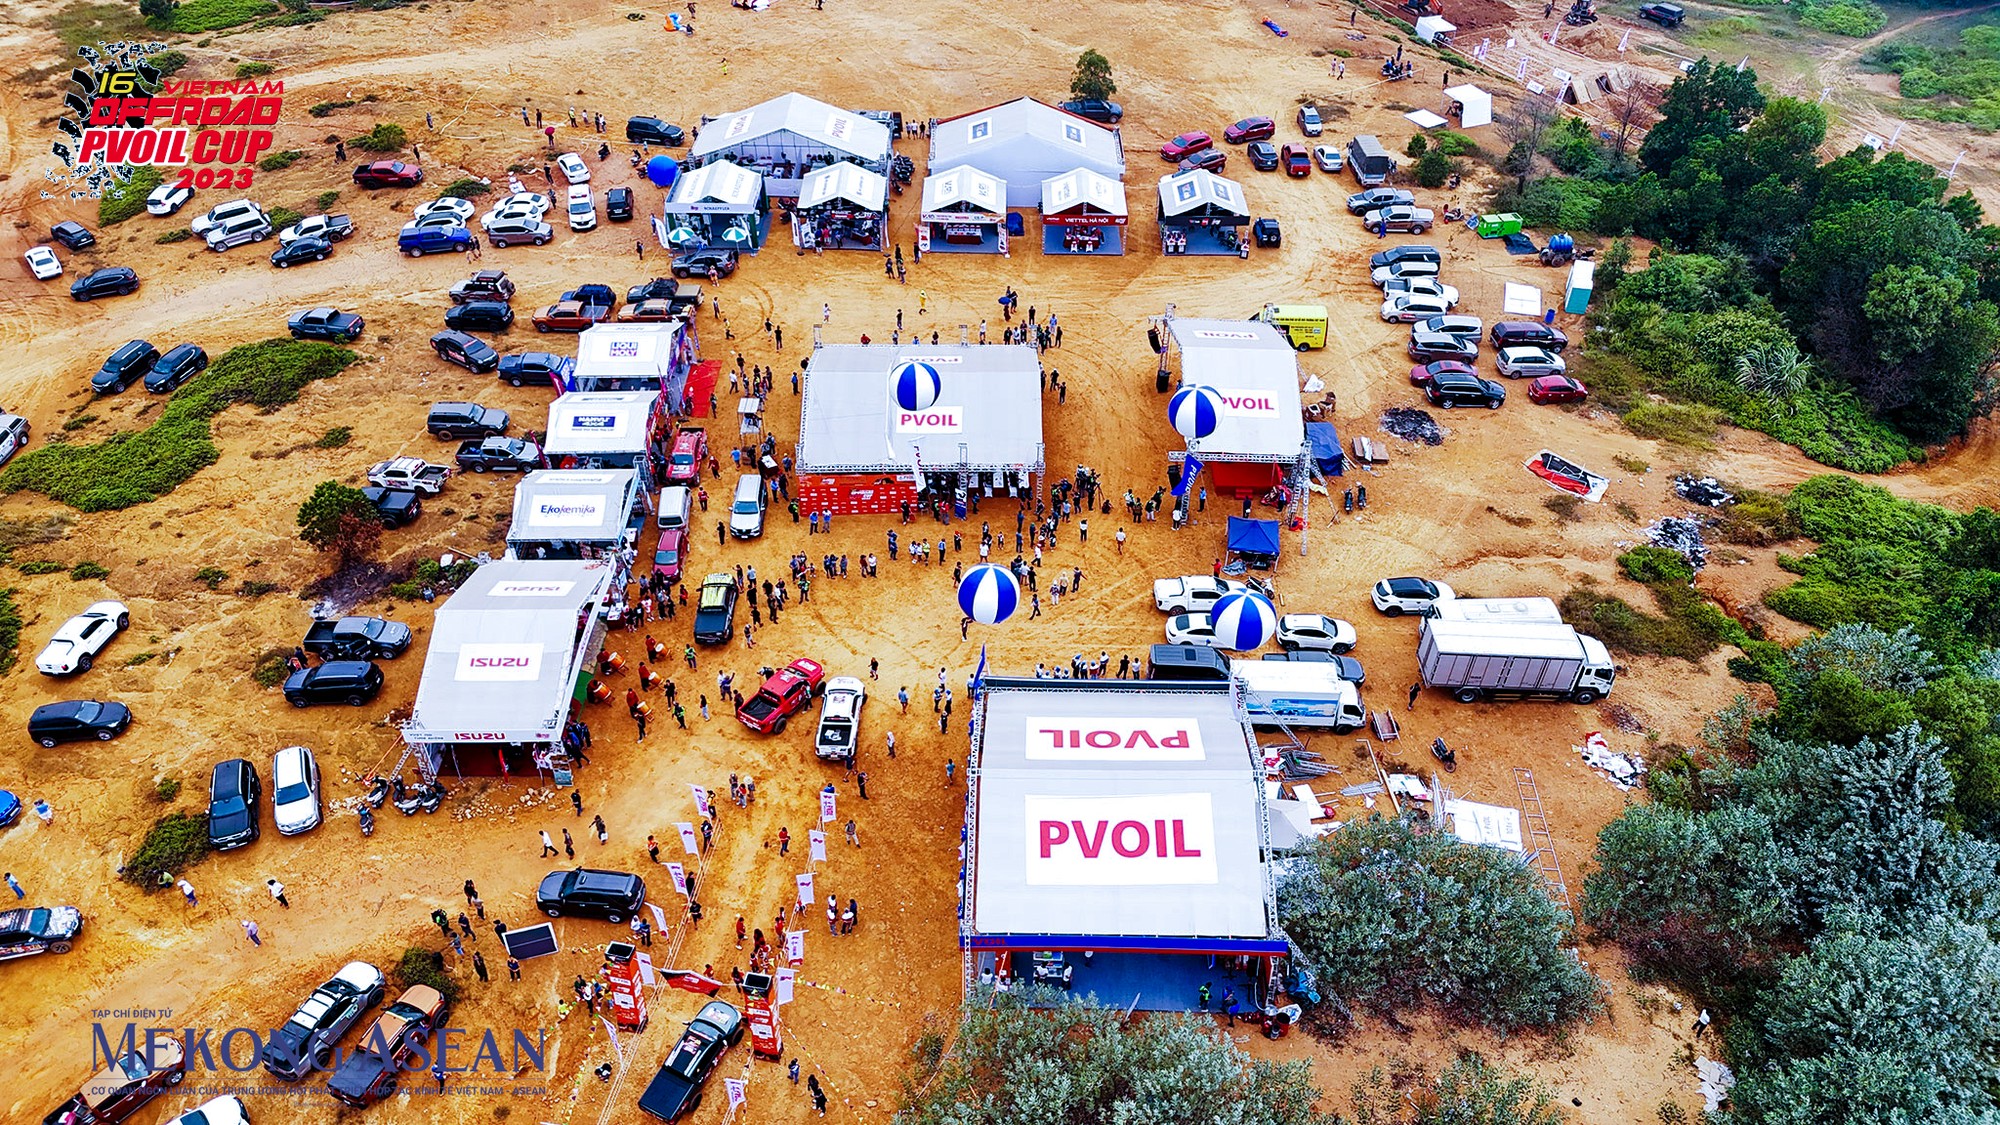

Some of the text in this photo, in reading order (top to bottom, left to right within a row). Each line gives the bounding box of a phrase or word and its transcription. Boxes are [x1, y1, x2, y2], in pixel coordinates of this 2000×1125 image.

[901, 413, 958, 426] PVOIL
[540, 504, 595, 514] Ekokemika
[470, 657, 529, 667] ISUZU
[1039, 729, 1190, 748] PVOIL
[1039, 819, 1202, 858] PVOIL
